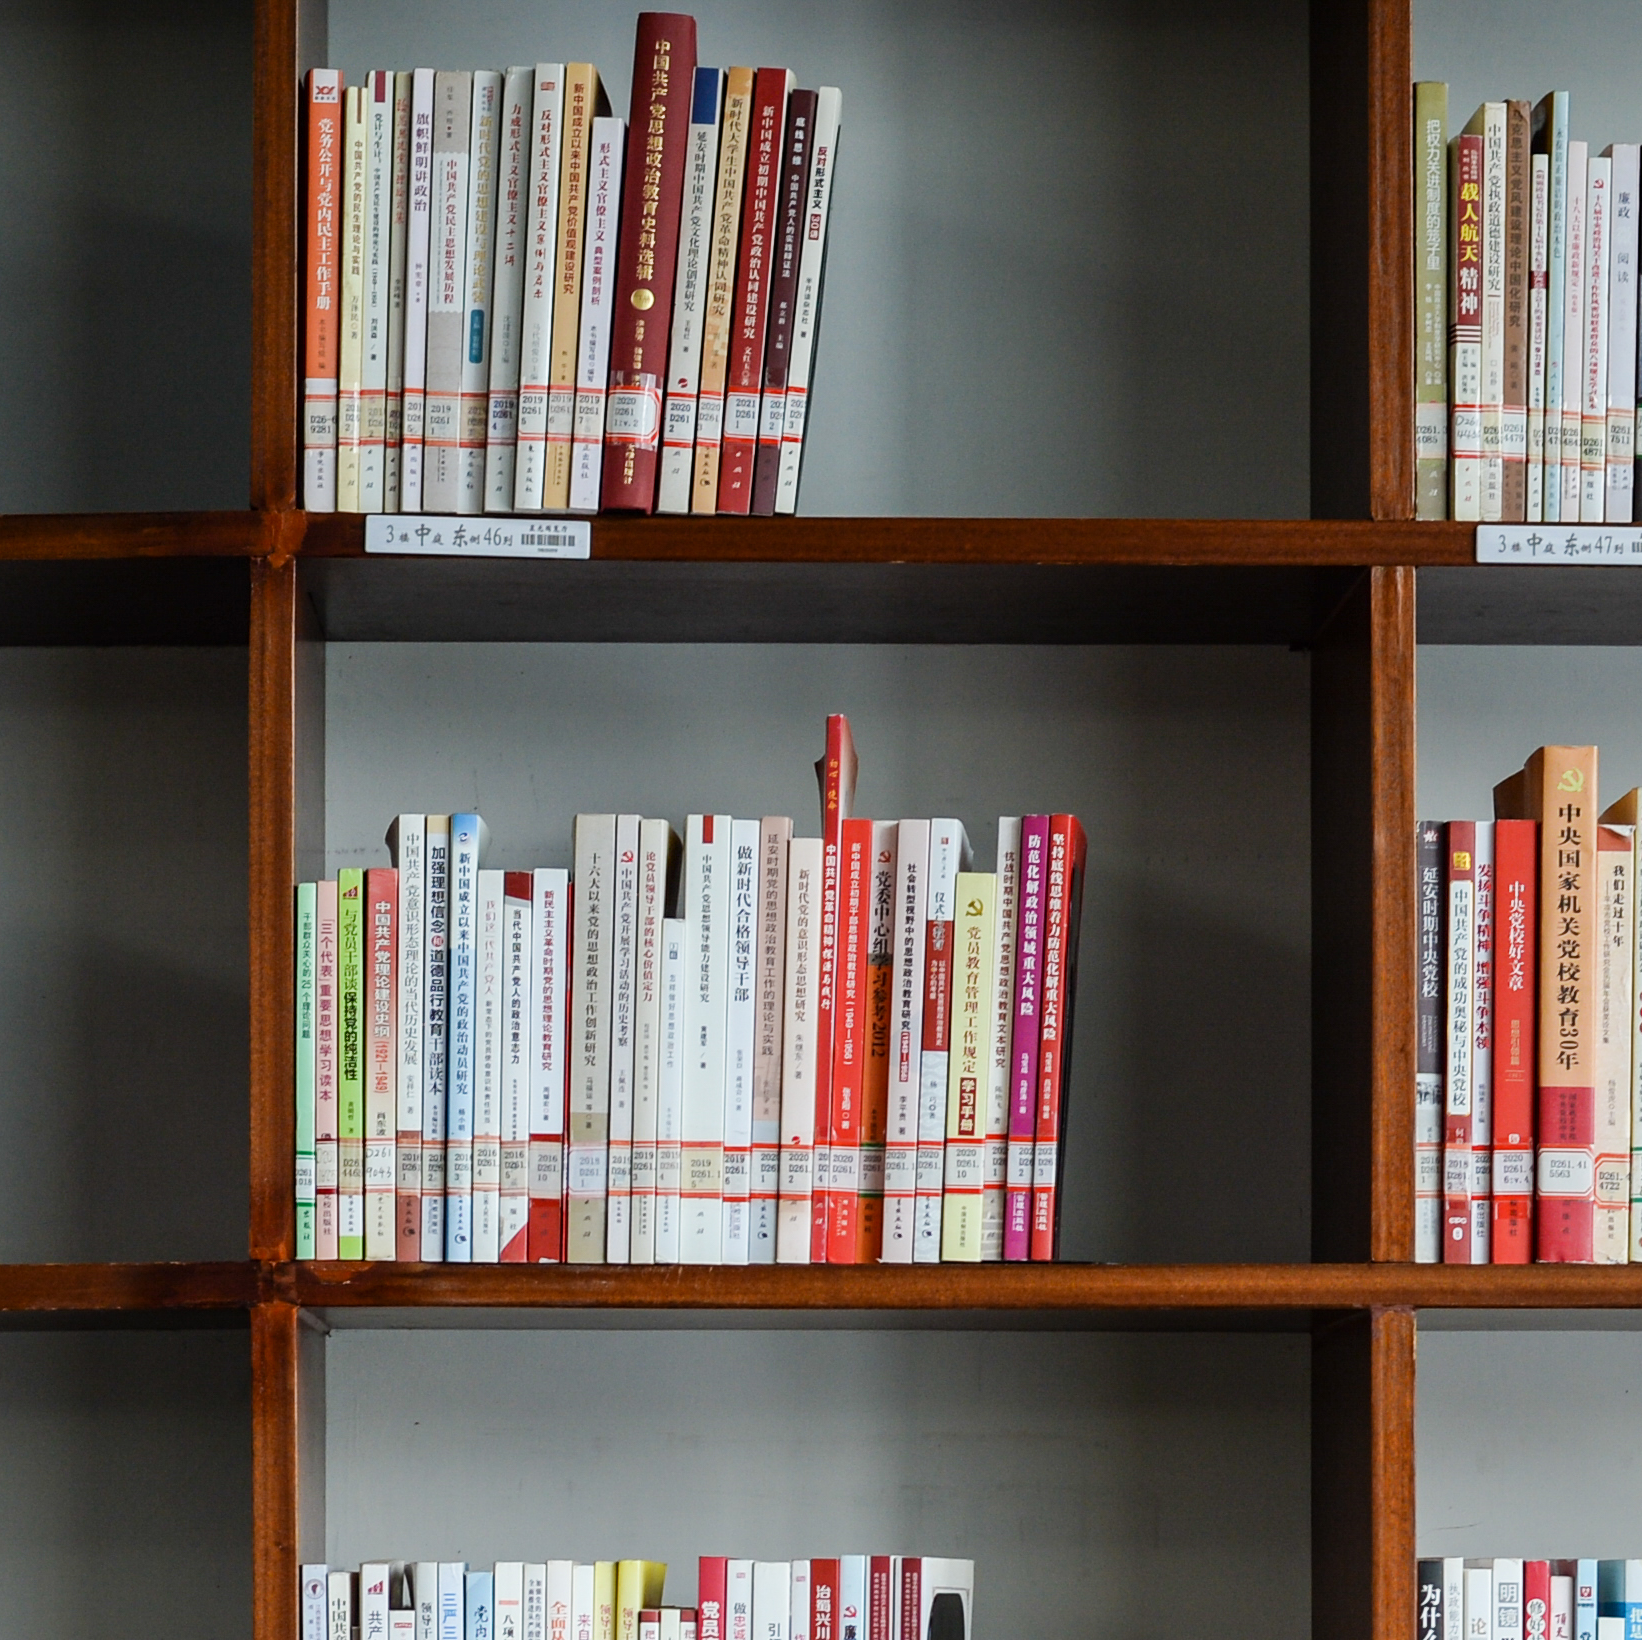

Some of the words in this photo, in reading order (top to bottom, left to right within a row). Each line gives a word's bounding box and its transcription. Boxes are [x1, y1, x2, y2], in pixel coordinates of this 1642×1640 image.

[1556, 804, 1581, 1070] 中央国家机关党校教育30年
